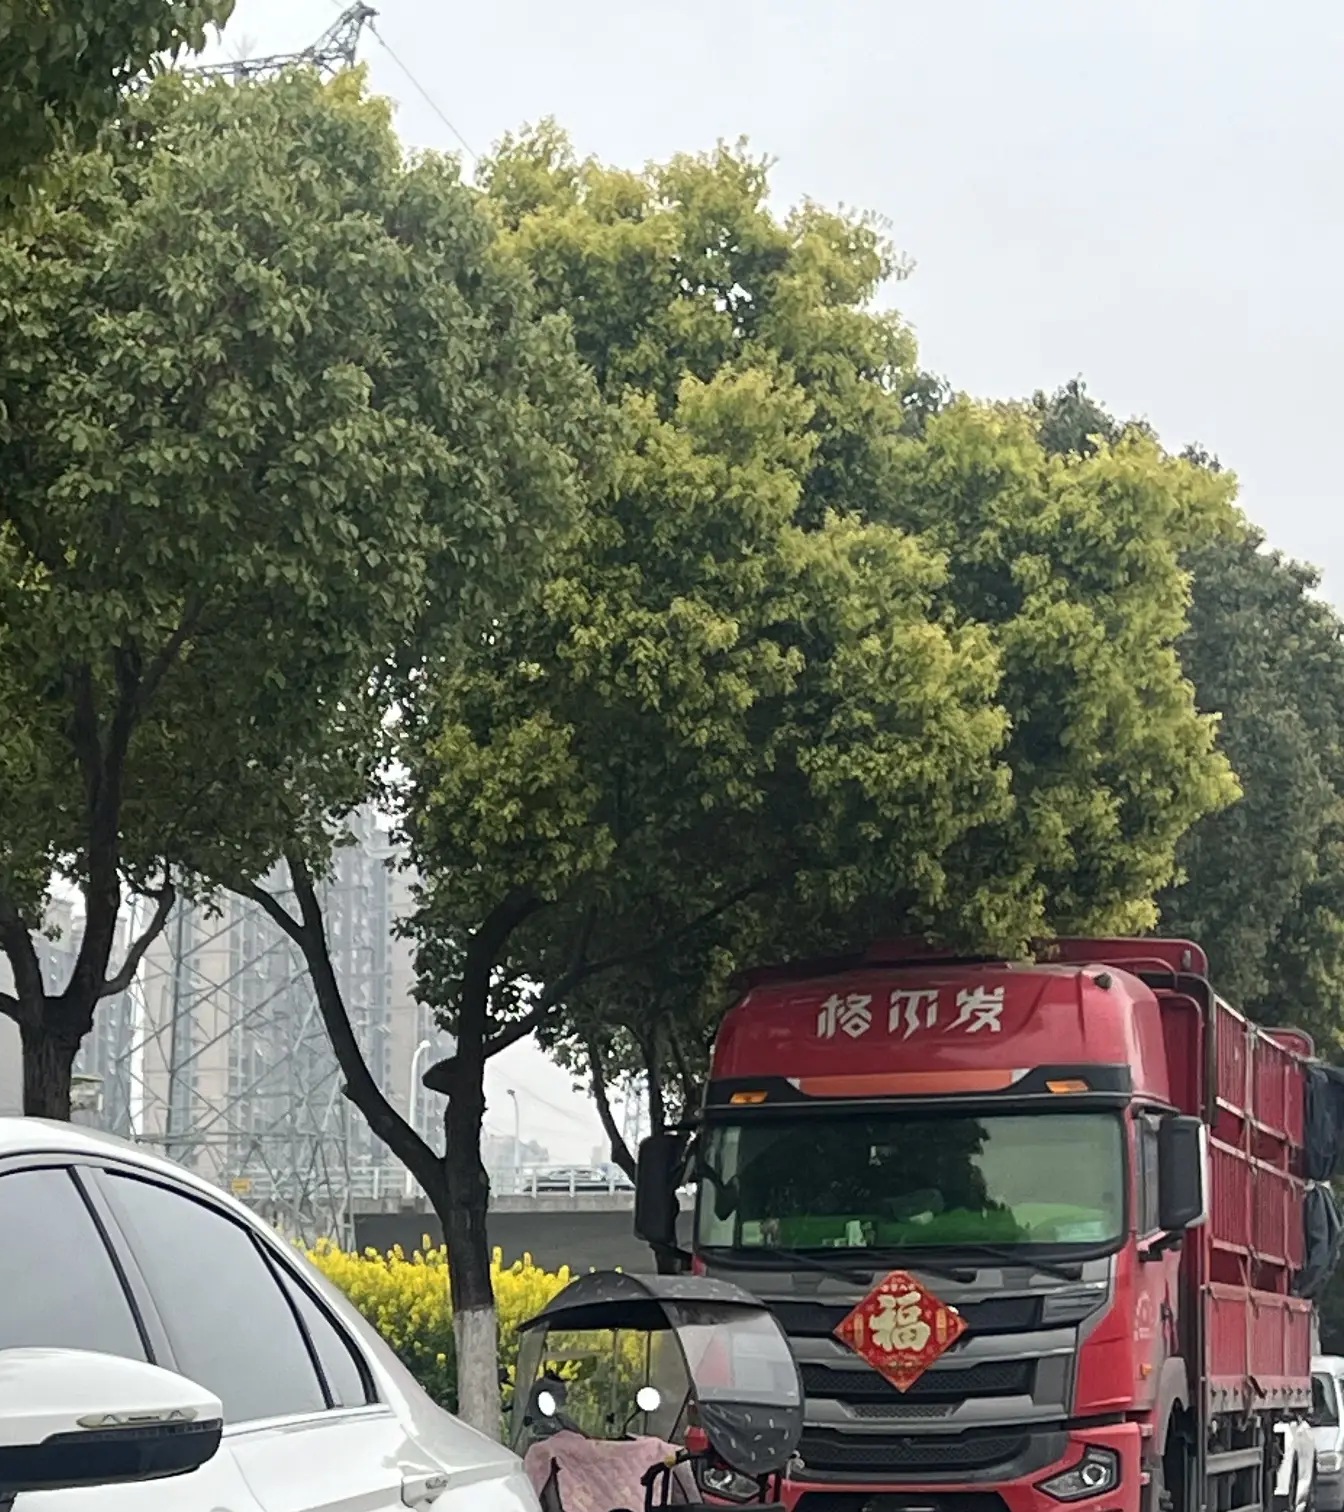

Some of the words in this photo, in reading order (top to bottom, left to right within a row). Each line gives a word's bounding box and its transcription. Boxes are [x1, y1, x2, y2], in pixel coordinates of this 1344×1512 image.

[817, 984, 1005, 1042] 格尔发
[869, 1291, 931, 1352] 福
